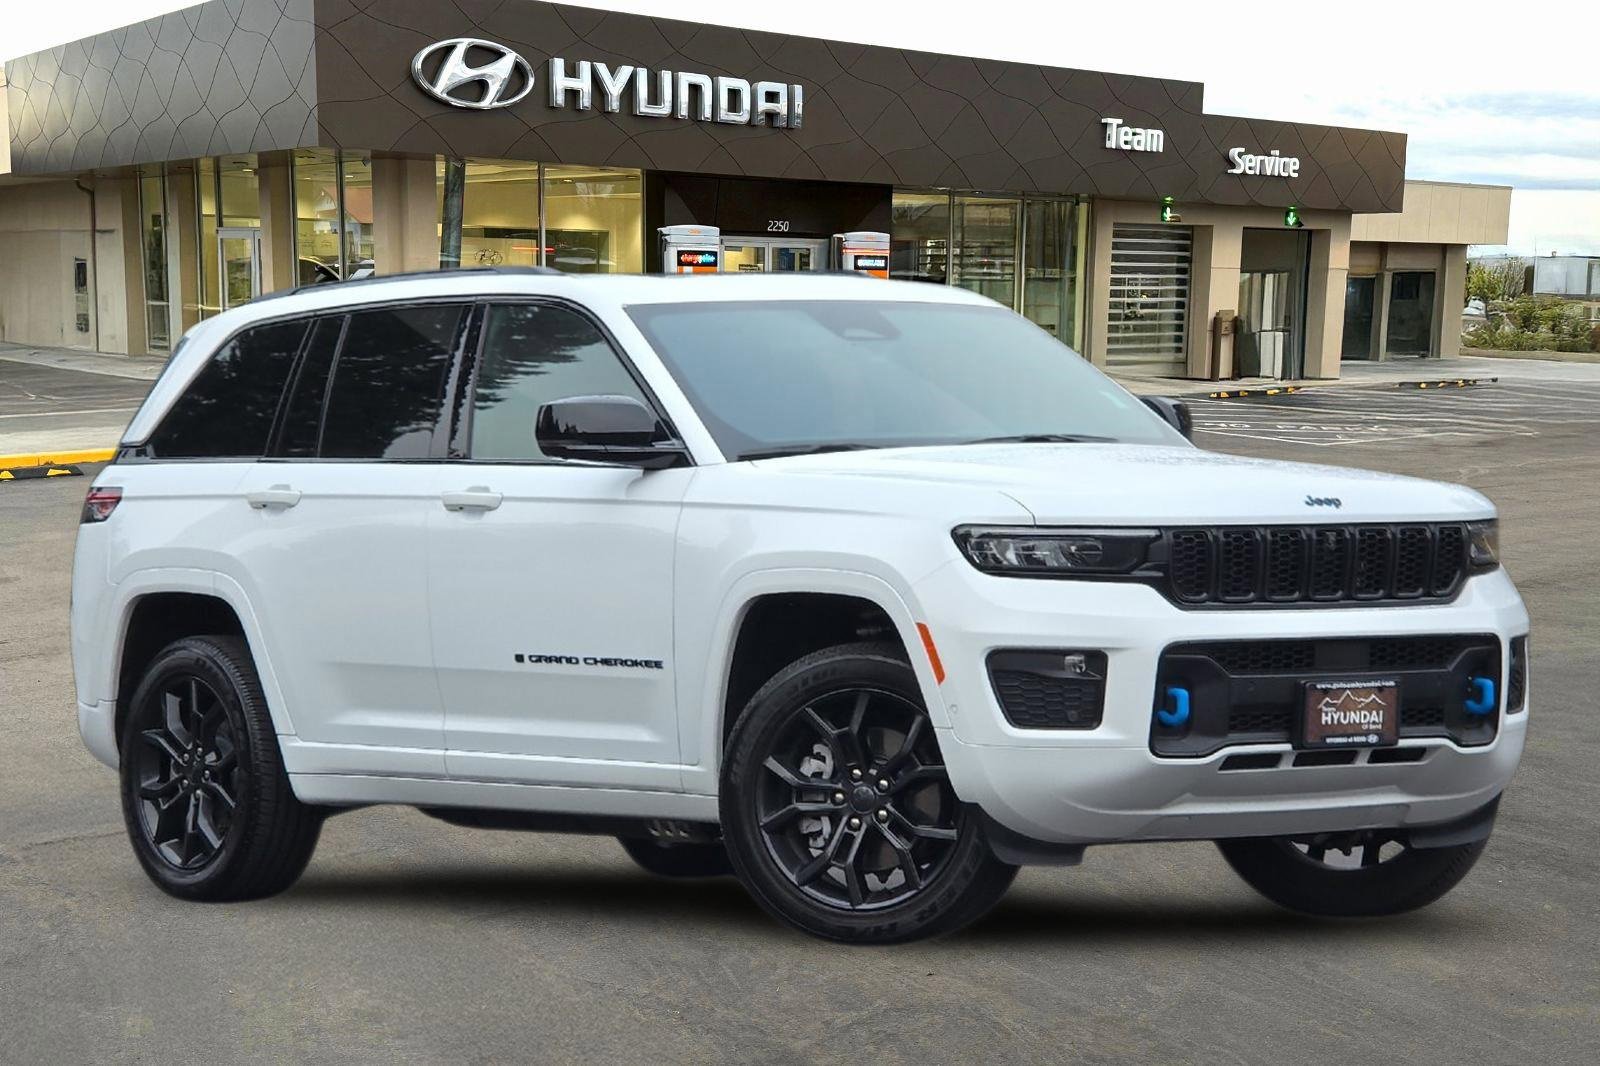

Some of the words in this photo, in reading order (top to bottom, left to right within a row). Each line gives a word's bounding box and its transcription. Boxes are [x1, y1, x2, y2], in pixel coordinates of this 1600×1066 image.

[548, 56, 804, 129] HYUNDAI
[1101, 117, 1164, 153] Team
[1227, 147, 1300, 178] Service
[767, 220, 790, 232] 2250
[1304, 494, 1342, 509] Jeep
[528, 654, 580, 665] GRAND
[584, 657, 663, 669] CHEROKEE
[1322, 710, 1383, 725] HYUNDAI
